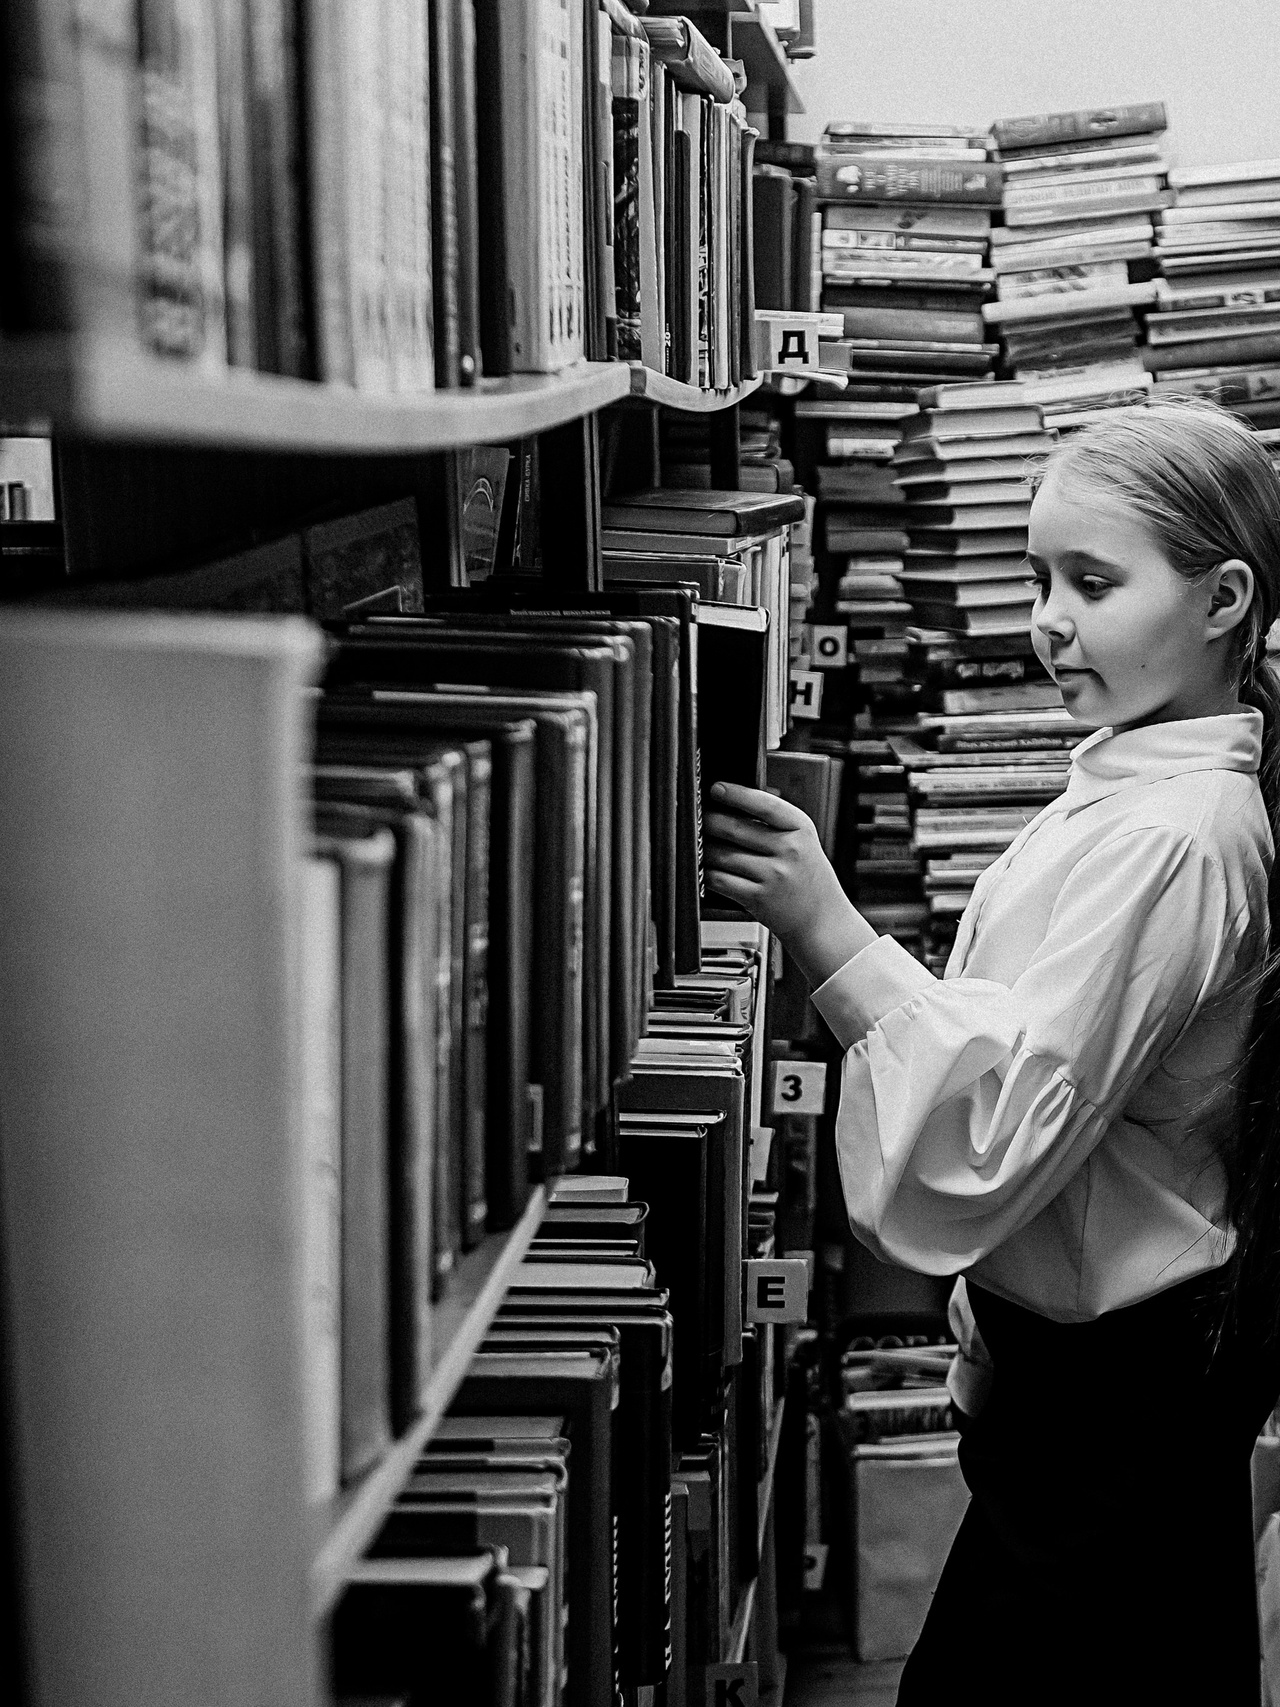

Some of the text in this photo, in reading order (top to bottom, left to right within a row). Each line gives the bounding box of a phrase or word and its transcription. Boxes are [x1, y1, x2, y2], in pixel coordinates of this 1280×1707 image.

[777, 330, 810, 364] Д
[819, 636, 841, 657] О
[791, 680, 814, 706] Н
[757, 1276, 786, 1309] Е
[714, 1678, 746, 1707] К
